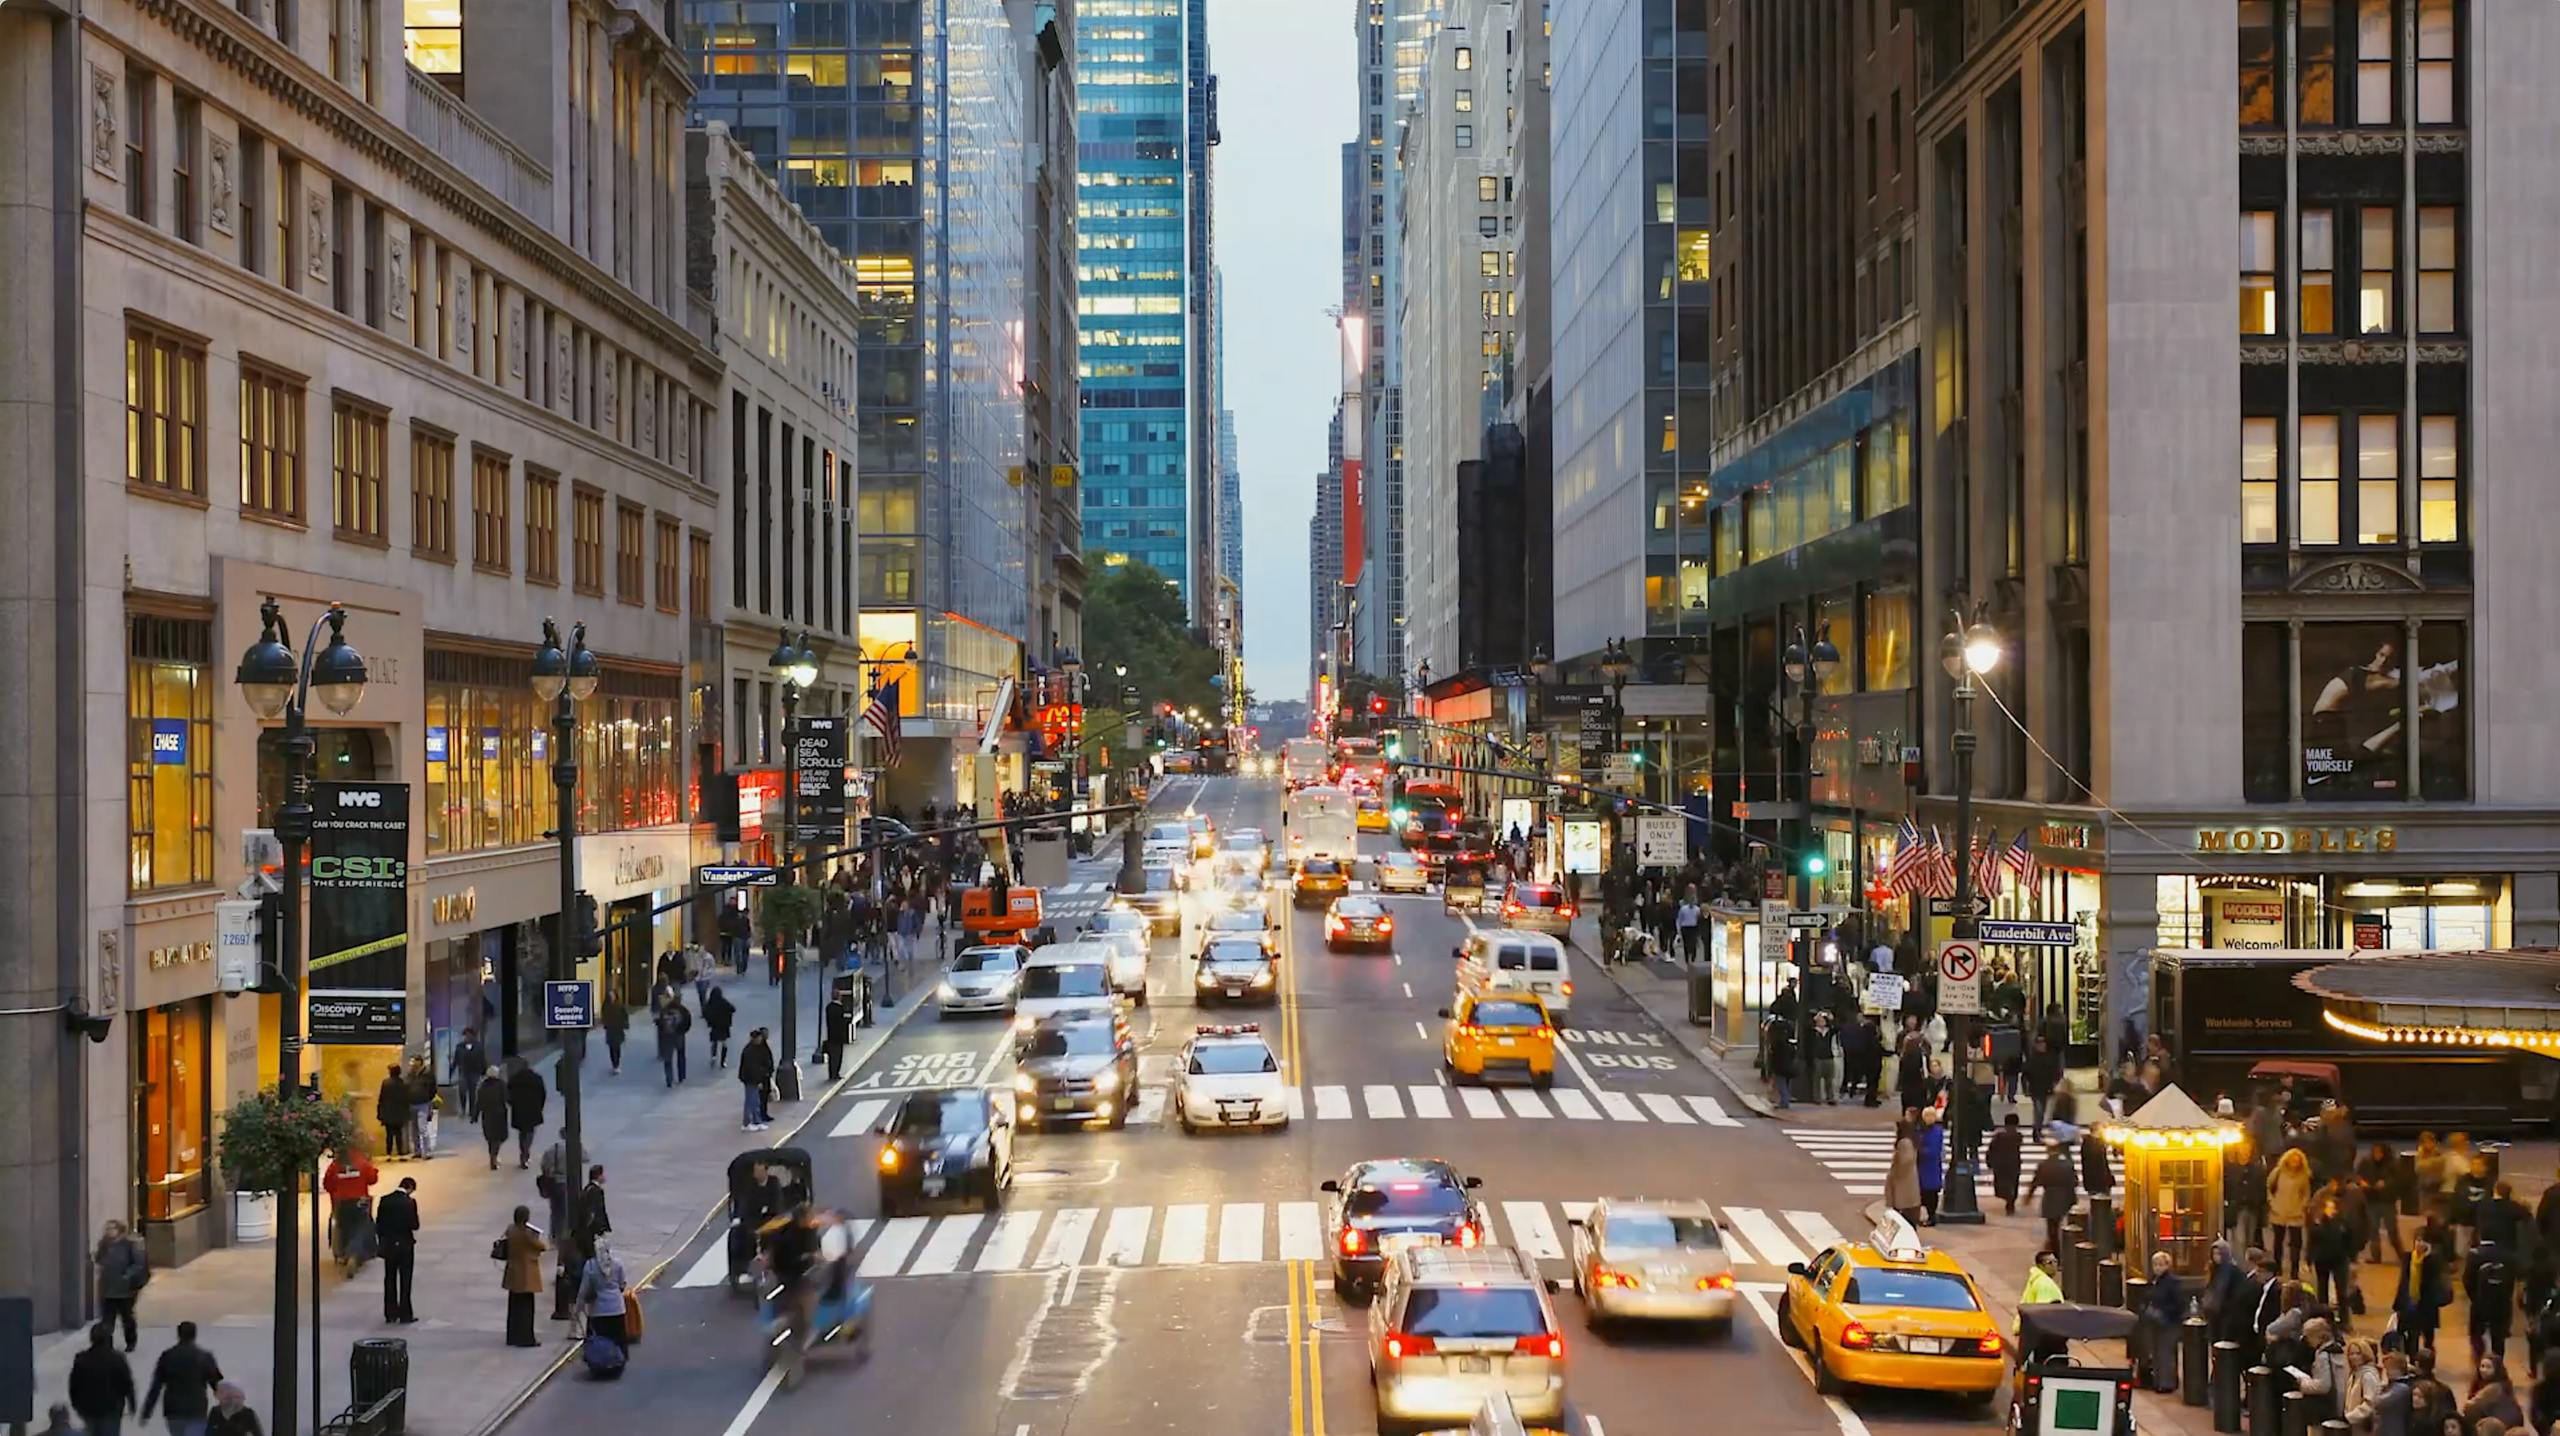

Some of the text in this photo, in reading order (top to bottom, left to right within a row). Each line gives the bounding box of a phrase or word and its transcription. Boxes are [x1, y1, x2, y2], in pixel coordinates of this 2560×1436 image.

[811, 720, 833, 730] NYC
[153, 733, 180, 752] CHASE
[799, 738, 829, 748] DEAD
[799, 748, 820, 758] SEA
[2306, 748, 2334, 760] MAKE
[799, 758, 844, 768] SCROLLS
[2306, 760, 2354, 773] YOURSELF
[814, 769, 830, 777] AND
[800, 782, 831, 790] BIBLICAL
[338, 790, 381, 807] NYC
[312, 820, 406, 830] CAN YOU CRACK THE CASE?
[1646, 820, 1678, 830] BUSES
[1649, 831, 1674, 840] ONLY
[2198, 828, 2398, 851] MODELL'S
[312, 855, 406, 879] CSI:
[338, 880, 405, 888] EXPERIENCE
[1768, 903, 1786, 912] BUS
[2223, 904, 2282, 917] MODELL'S
[1981, 926, 2072, 941] Vanderbilt Ave
[557, 984, 580, 993] NYPD
[313, 1003, 364, 1016] Discovery
[554, 1005, 584, 1014] Security
[2205, 1017, 2293, 1028] Worldwide Services
[1560, 1028, 1664, 1047] ONLY
[893, 1051, 978, 1070] BUS
[1585, 1053, 1678, 1070] BUS
[851, 1067, 976, 1089] ONLY
